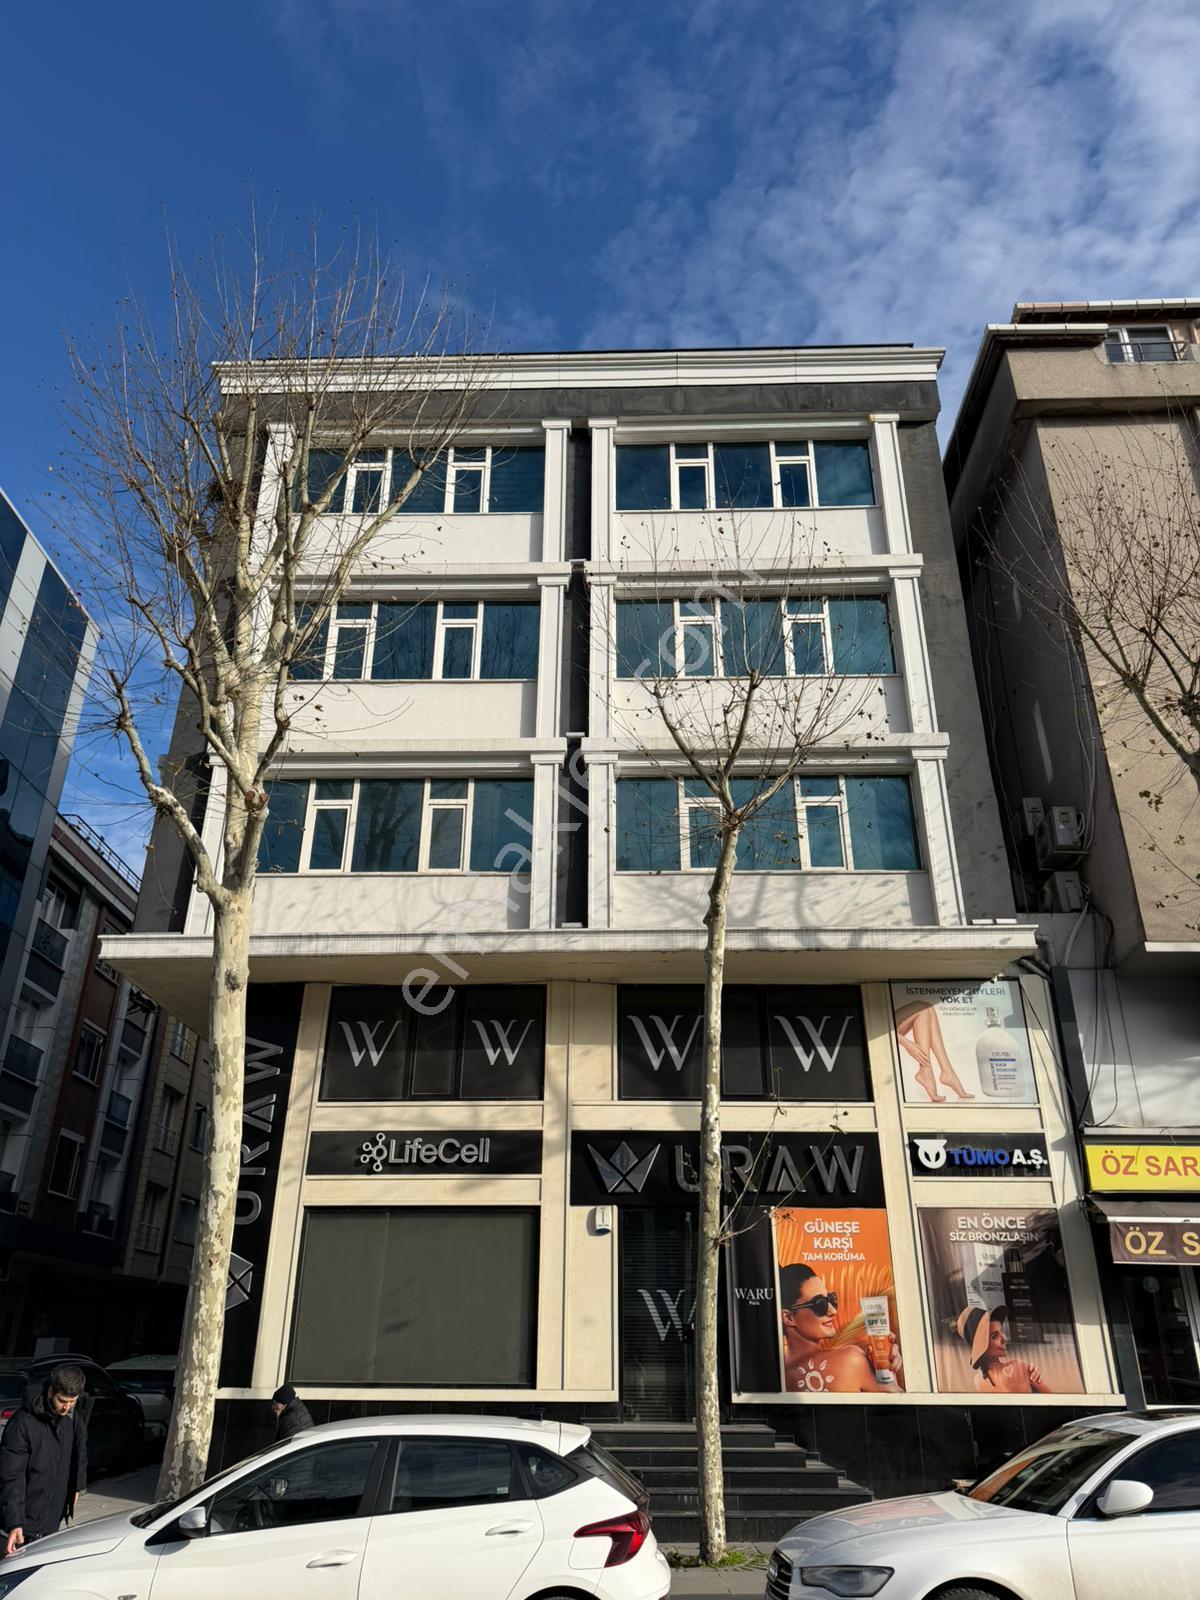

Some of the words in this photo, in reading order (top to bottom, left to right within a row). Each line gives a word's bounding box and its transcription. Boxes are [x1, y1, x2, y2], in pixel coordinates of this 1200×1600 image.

[940, 996, 960, 1004] YOK
[962, 996, 974, 1004] ET
[389, 1136, 491, 1164] LifeCell
[949, 1147, 1010, 1166] TÜMO
[1012, 1148, 1049, 1170] A.Ş.
[674, 1144, 865, 1193] URAW
[1101, 1149, 1139, 1176] ÖZ
[804, 1218, 860, 1238] GÜNEŞE
[957, 1216, 979, 1229] EN
[981, 1213, 1027, 1229] ÖNCE
[813, 1237, 853, 1252] KARŞI
[949, 1229, 967, 1242] SİZ
[968, 1231, 1039, 1244] BRONZLAŞIN
[1124, 1225, 1167, 1256] ÖZ
[802, 1252, 824, 1261] TAM
[824, 1252, 865, 1261] KORUMA
[734, 1288, 774, 1300] WARU
